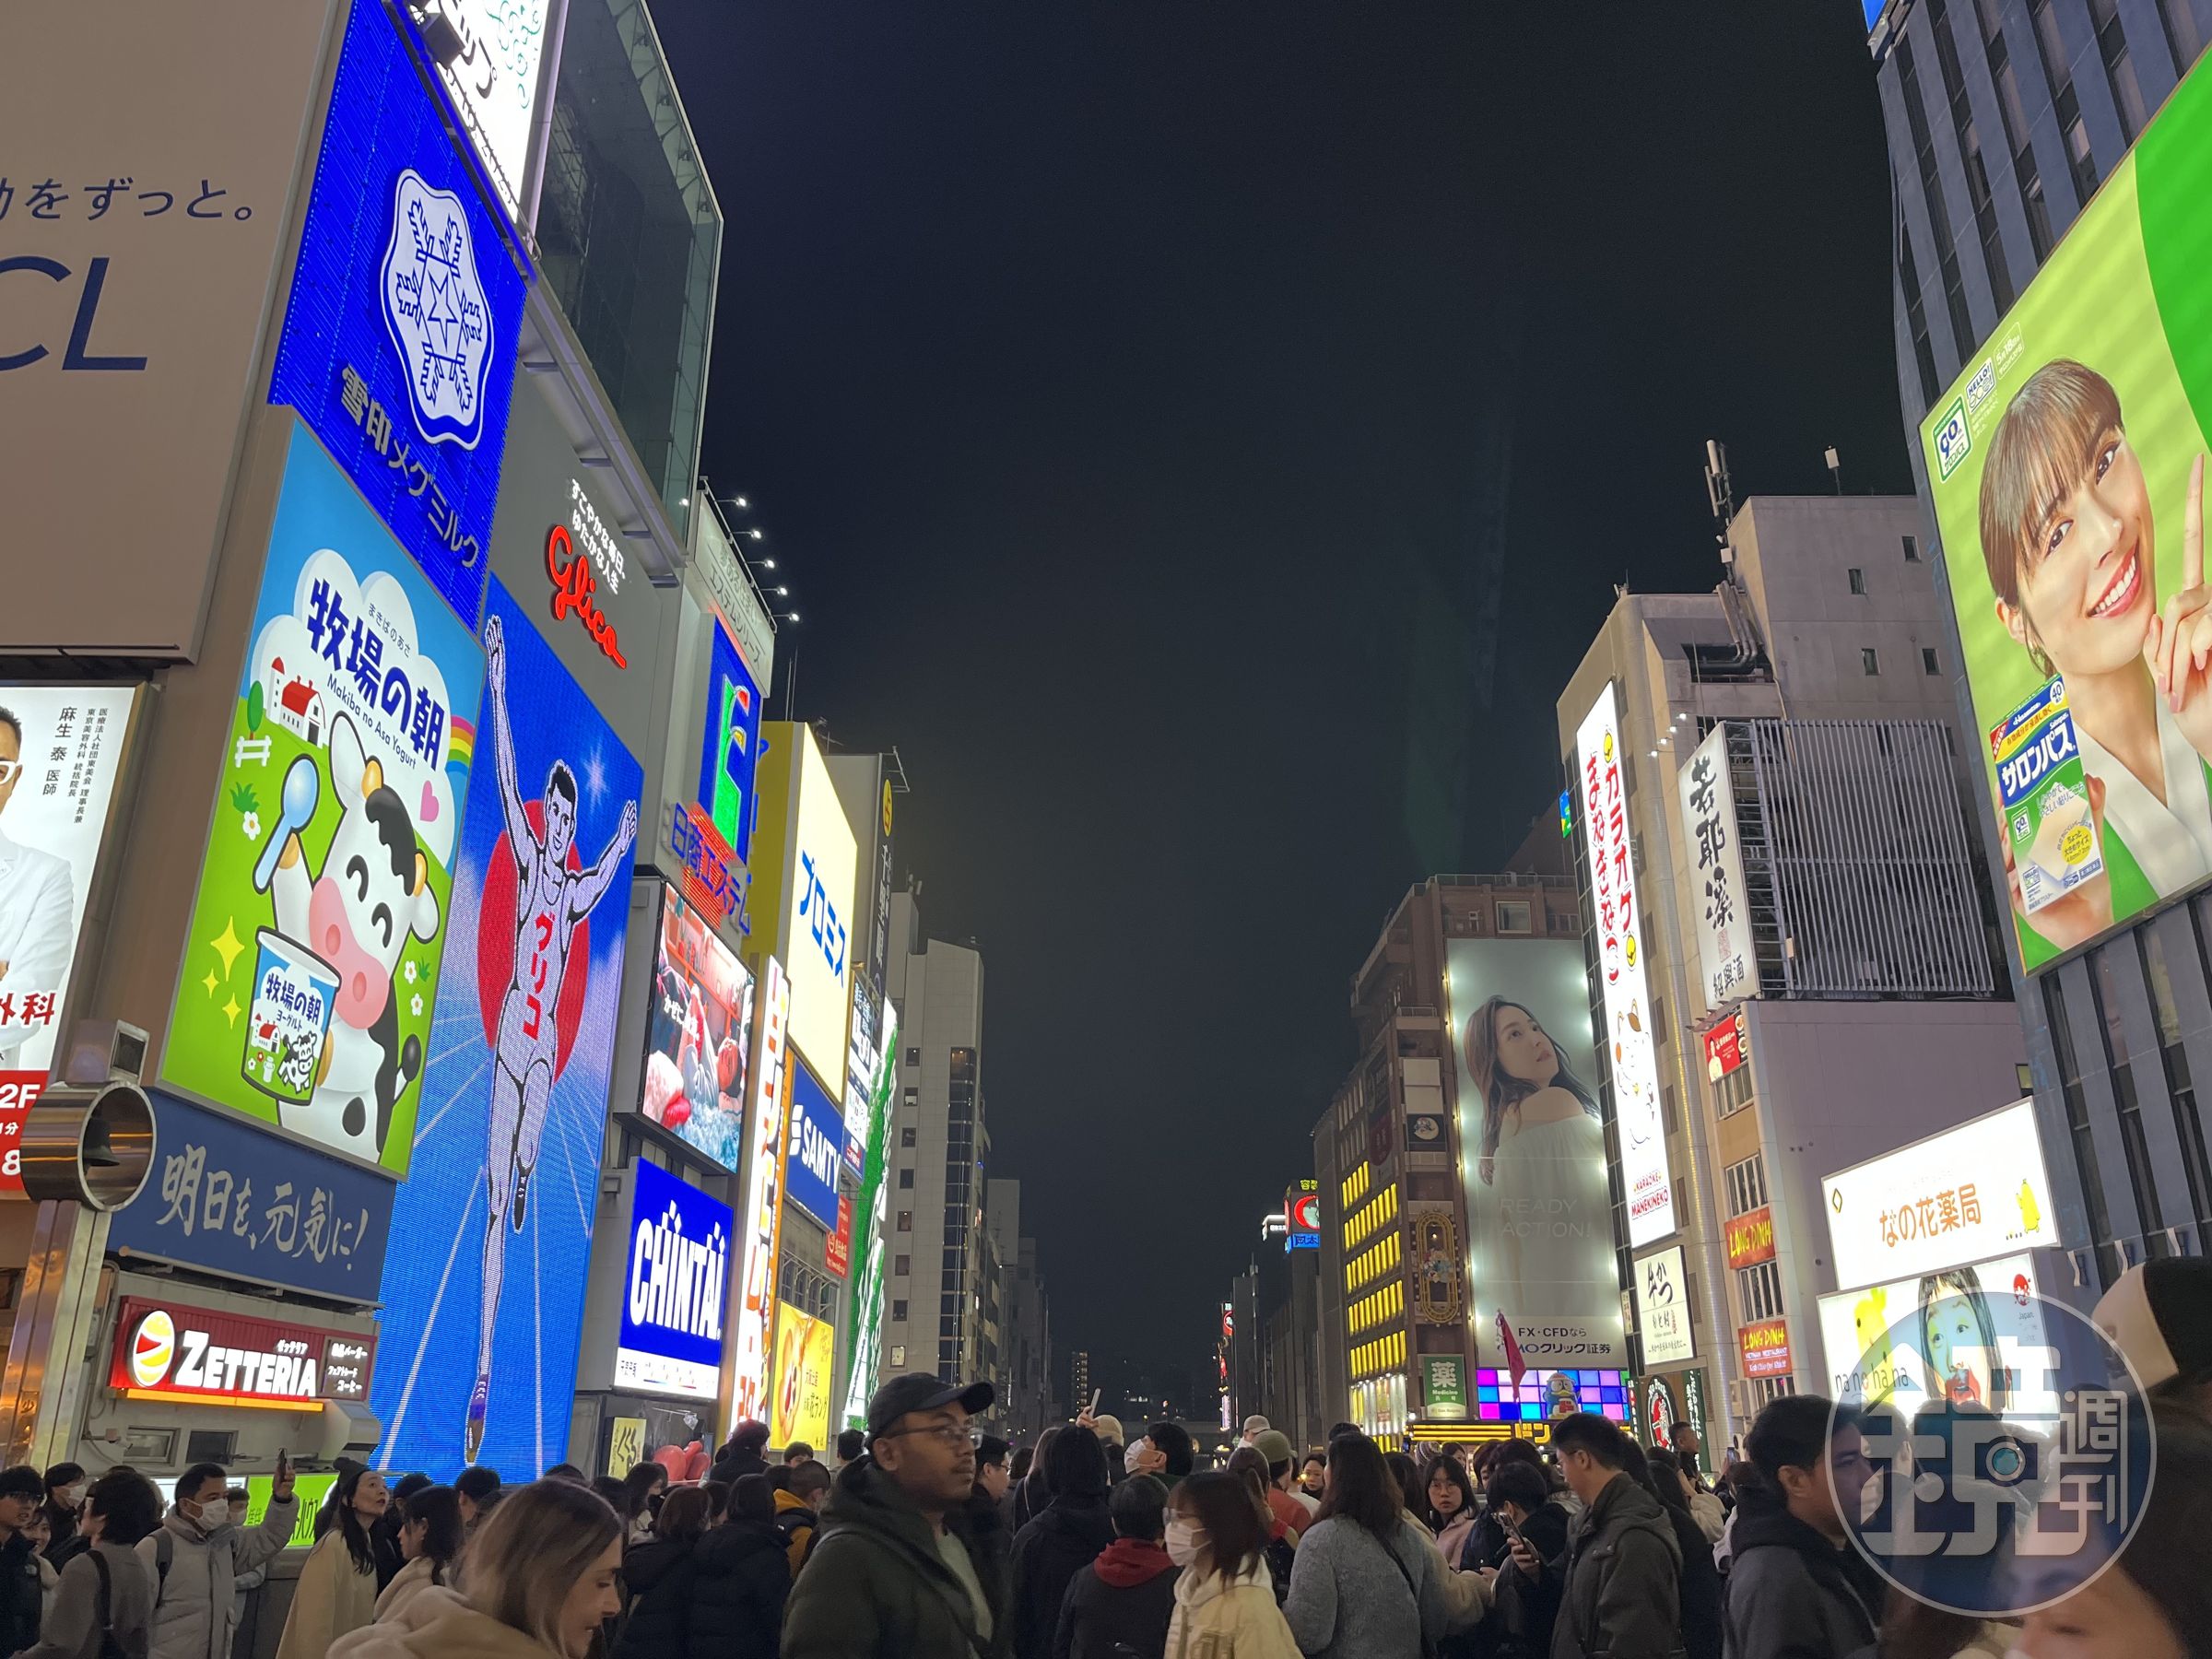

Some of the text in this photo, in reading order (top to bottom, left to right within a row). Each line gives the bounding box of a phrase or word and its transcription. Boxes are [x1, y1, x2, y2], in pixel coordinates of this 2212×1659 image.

[0, 177, 253, 221] をずっと。
[341, 362, 479, 568] 雪印メグミルク
[572, 509, 618, 595] ゆたかな人生
[547, 525, 627, 669] Glico
[369, 603, 412, 658] まきばのあさ
[307, 577, 445, 771] 牧場の朝
[2052, 684, 2062, 700] 40
[55, 706, 77, 738] 麻生
[327, 673, 417, 770] Makiba no Asa Yogurt
[42, 770, 61, 795] 医師
[2002, 722, 2074, 797] サロンパス
[1586, 755, 1619, 983] まねきねこ
[1605, 762, 1632, 933] カラオケ
[799, 849, 845, 989] プロミス
[265, 972, 322, 1026] 牧場の朝
[1713, 954, 1745, 999] 紹興酒
[276, 1009, 302, 1032] ヨーグルト
[801, 1115, 841, 1194] SAMTY
[1500, 1199, 1578, 1214] READY
[1631, 1190, 1669, 1217] MANEKINEKO
[1635, 1174, 1659, 1192] KARAOKE
[1500, 1221, 1592, 1238] ACTION!
[1879, 1182, 1982, 1248] なの花薬局
[629, 1200, 724, 1341] CHINTAI
[175, 1329, 317, 1397] ZETTERIA
[1744, 1330, 1763, 1350] LONG
[1431, 1361, 1456, 1387] 薬
[1515, 1423, 1551, 1443] ドン
